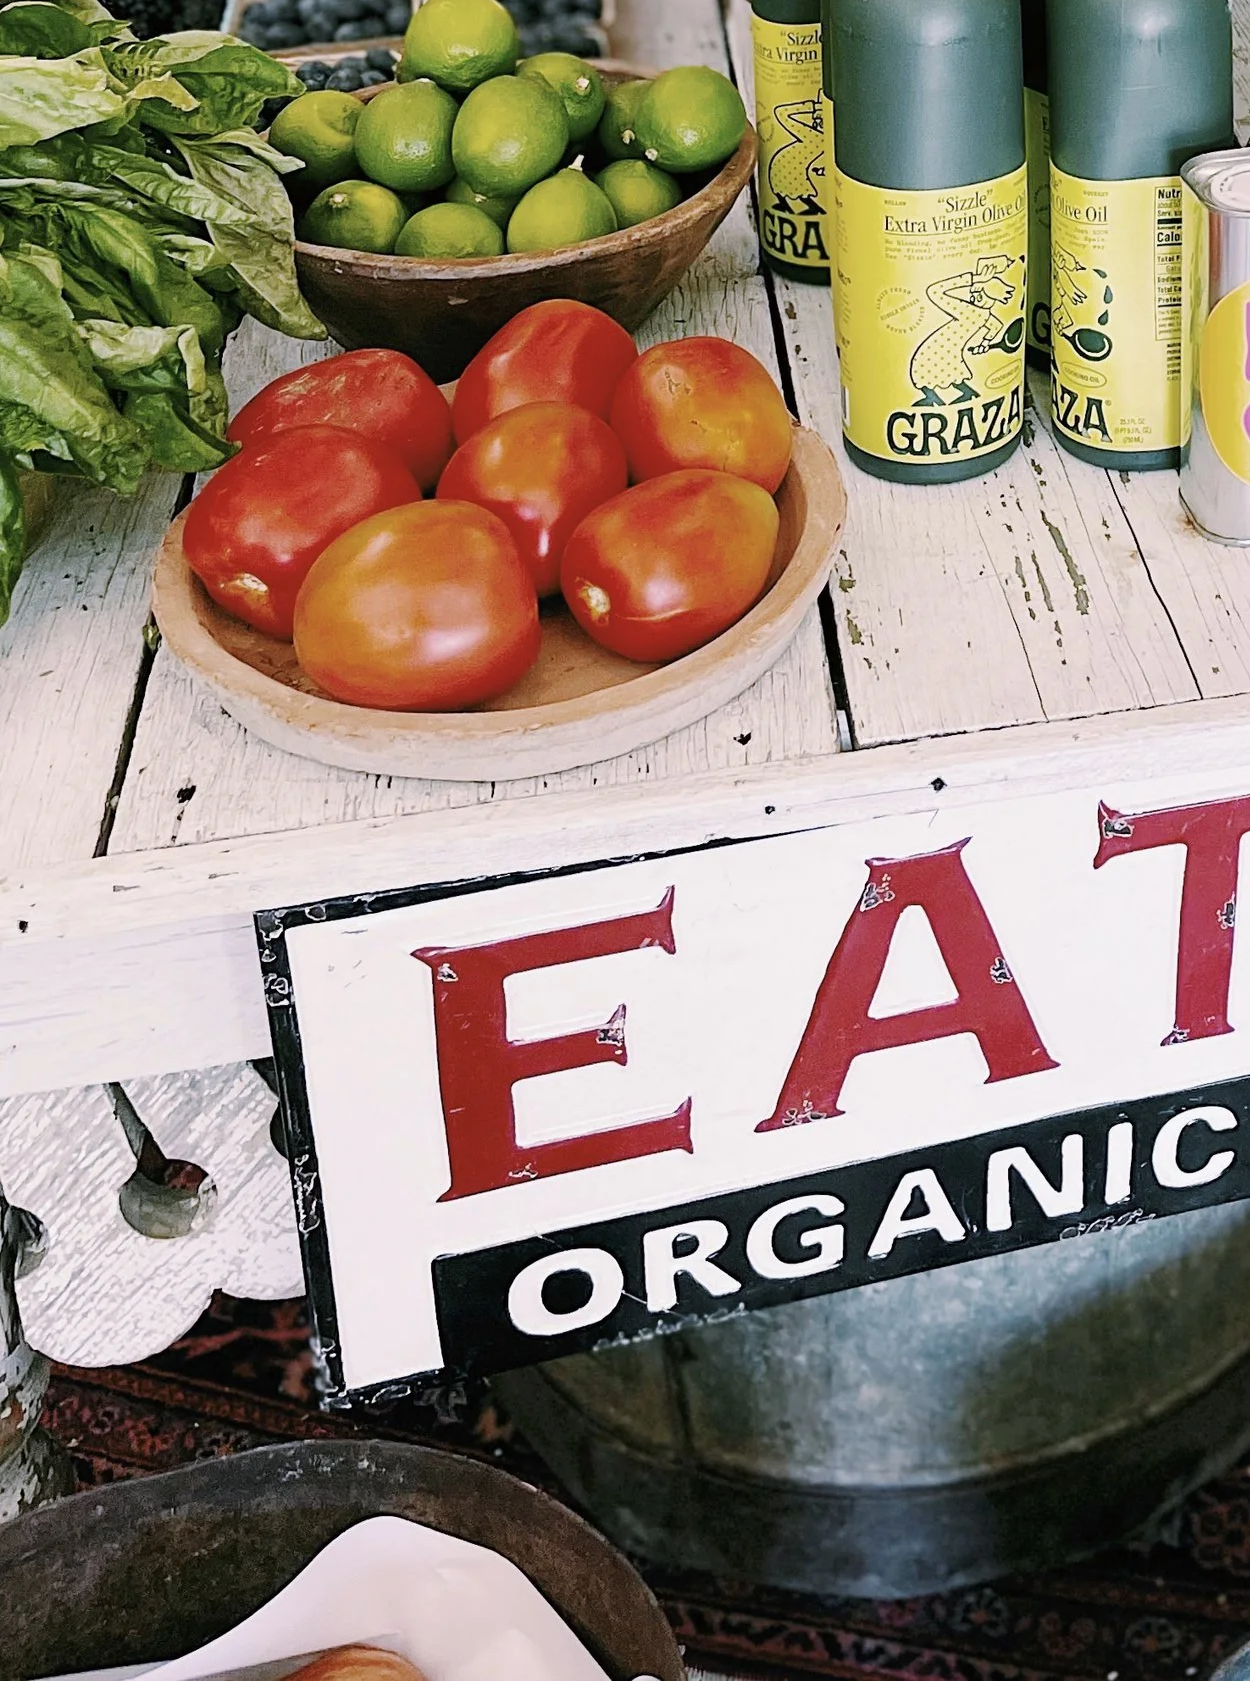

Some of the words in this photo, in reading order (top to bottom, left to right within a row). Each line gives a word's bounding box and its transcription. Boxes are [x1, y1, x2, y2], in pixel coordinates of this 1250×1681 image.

[776, 46, 818, 66] Virgin
[763, 208, 831, 261] GRA
[884, 214, 927, 233] Extra
[931, 212, 977, 235] Virgin
[982, 203, 1013, 224] Olive
[1055, 195, 1081, 220] Olive
[1085, 205, 1107, 223] Oil
[887, 384, 1022, 457] GRAZA
[1051, 372, 1113, 443] AZA
[508, 1105, 1239, 1337] ORGANIC
